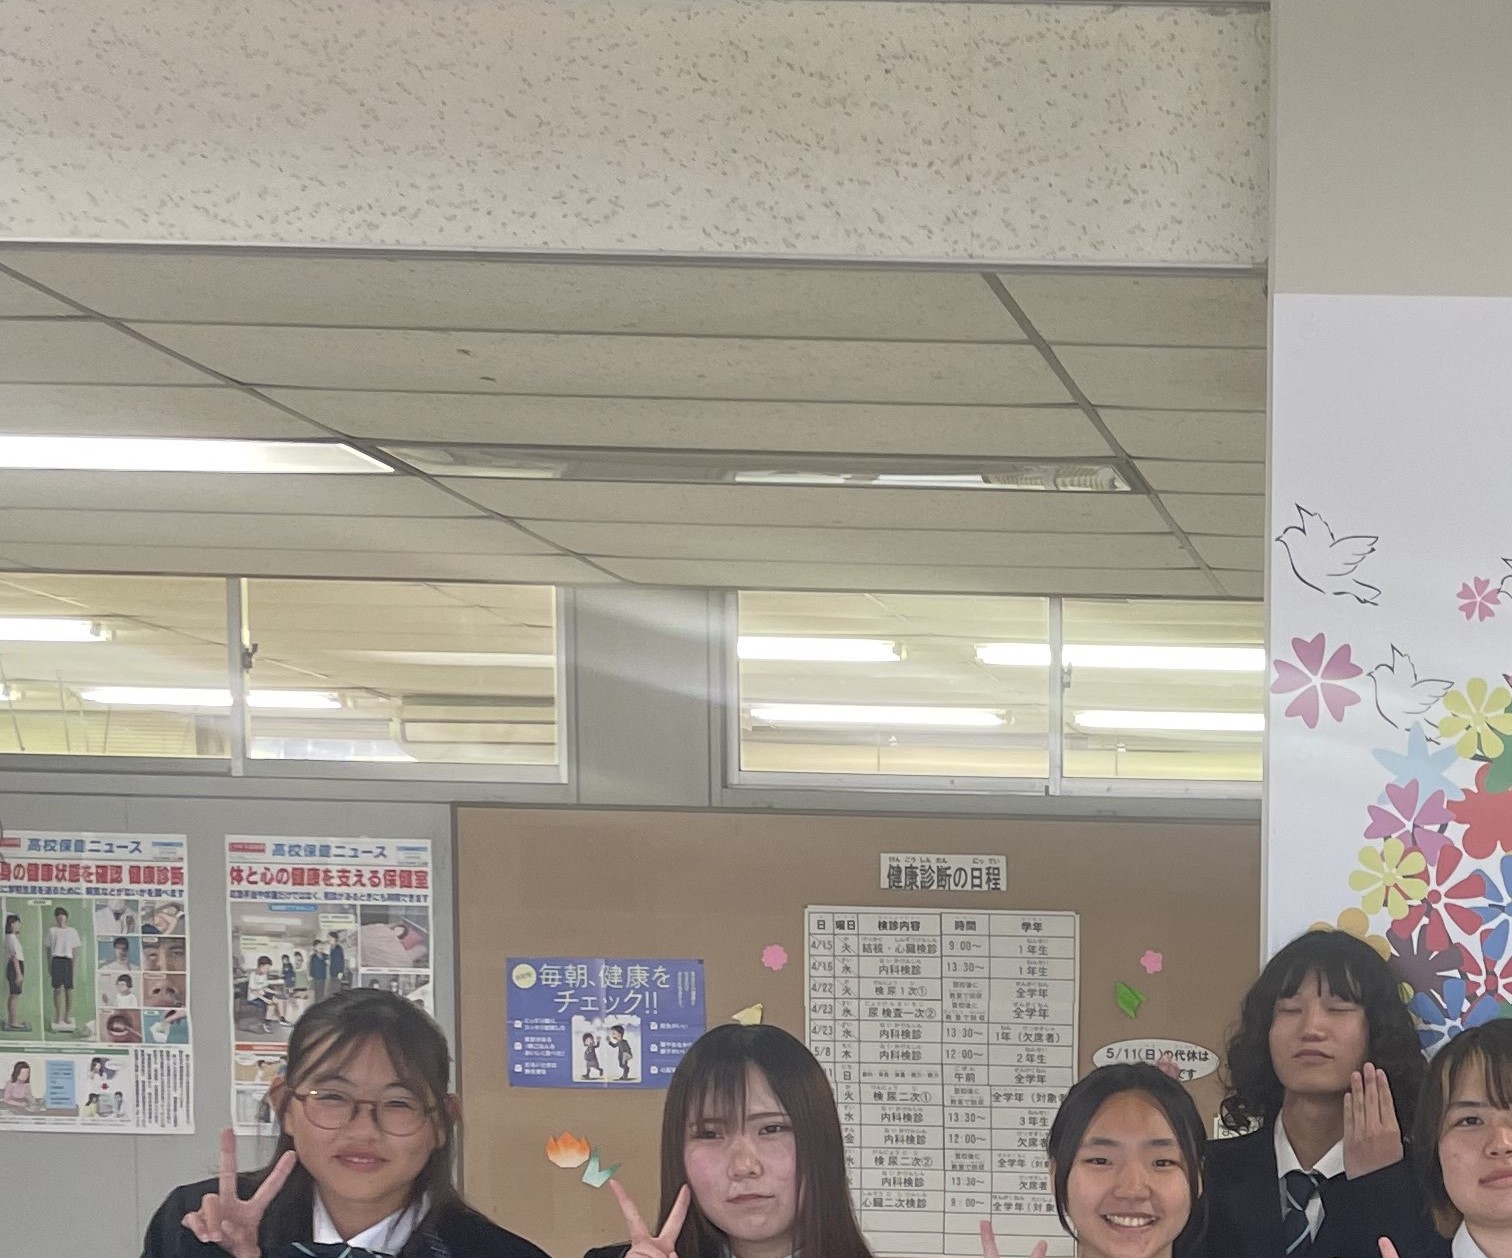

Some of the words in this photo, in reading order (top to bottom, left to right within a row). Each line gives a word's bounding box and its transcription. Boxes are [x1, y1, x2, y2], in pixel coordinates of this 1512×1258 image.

[887, 863, 1001, 890] 健康診断の日程
[817, 920, 826, 930] 日
[835, 920, 856, 931] 曜日
[954, 920, 977, 931] 時間
[1021, 922, 1043, 932] 学年
[539, 963, 670, 988] 毎朝、健康を
[815, 1047, 831, 1057] 5/8
[843, 1071, 851, 1080] 日
